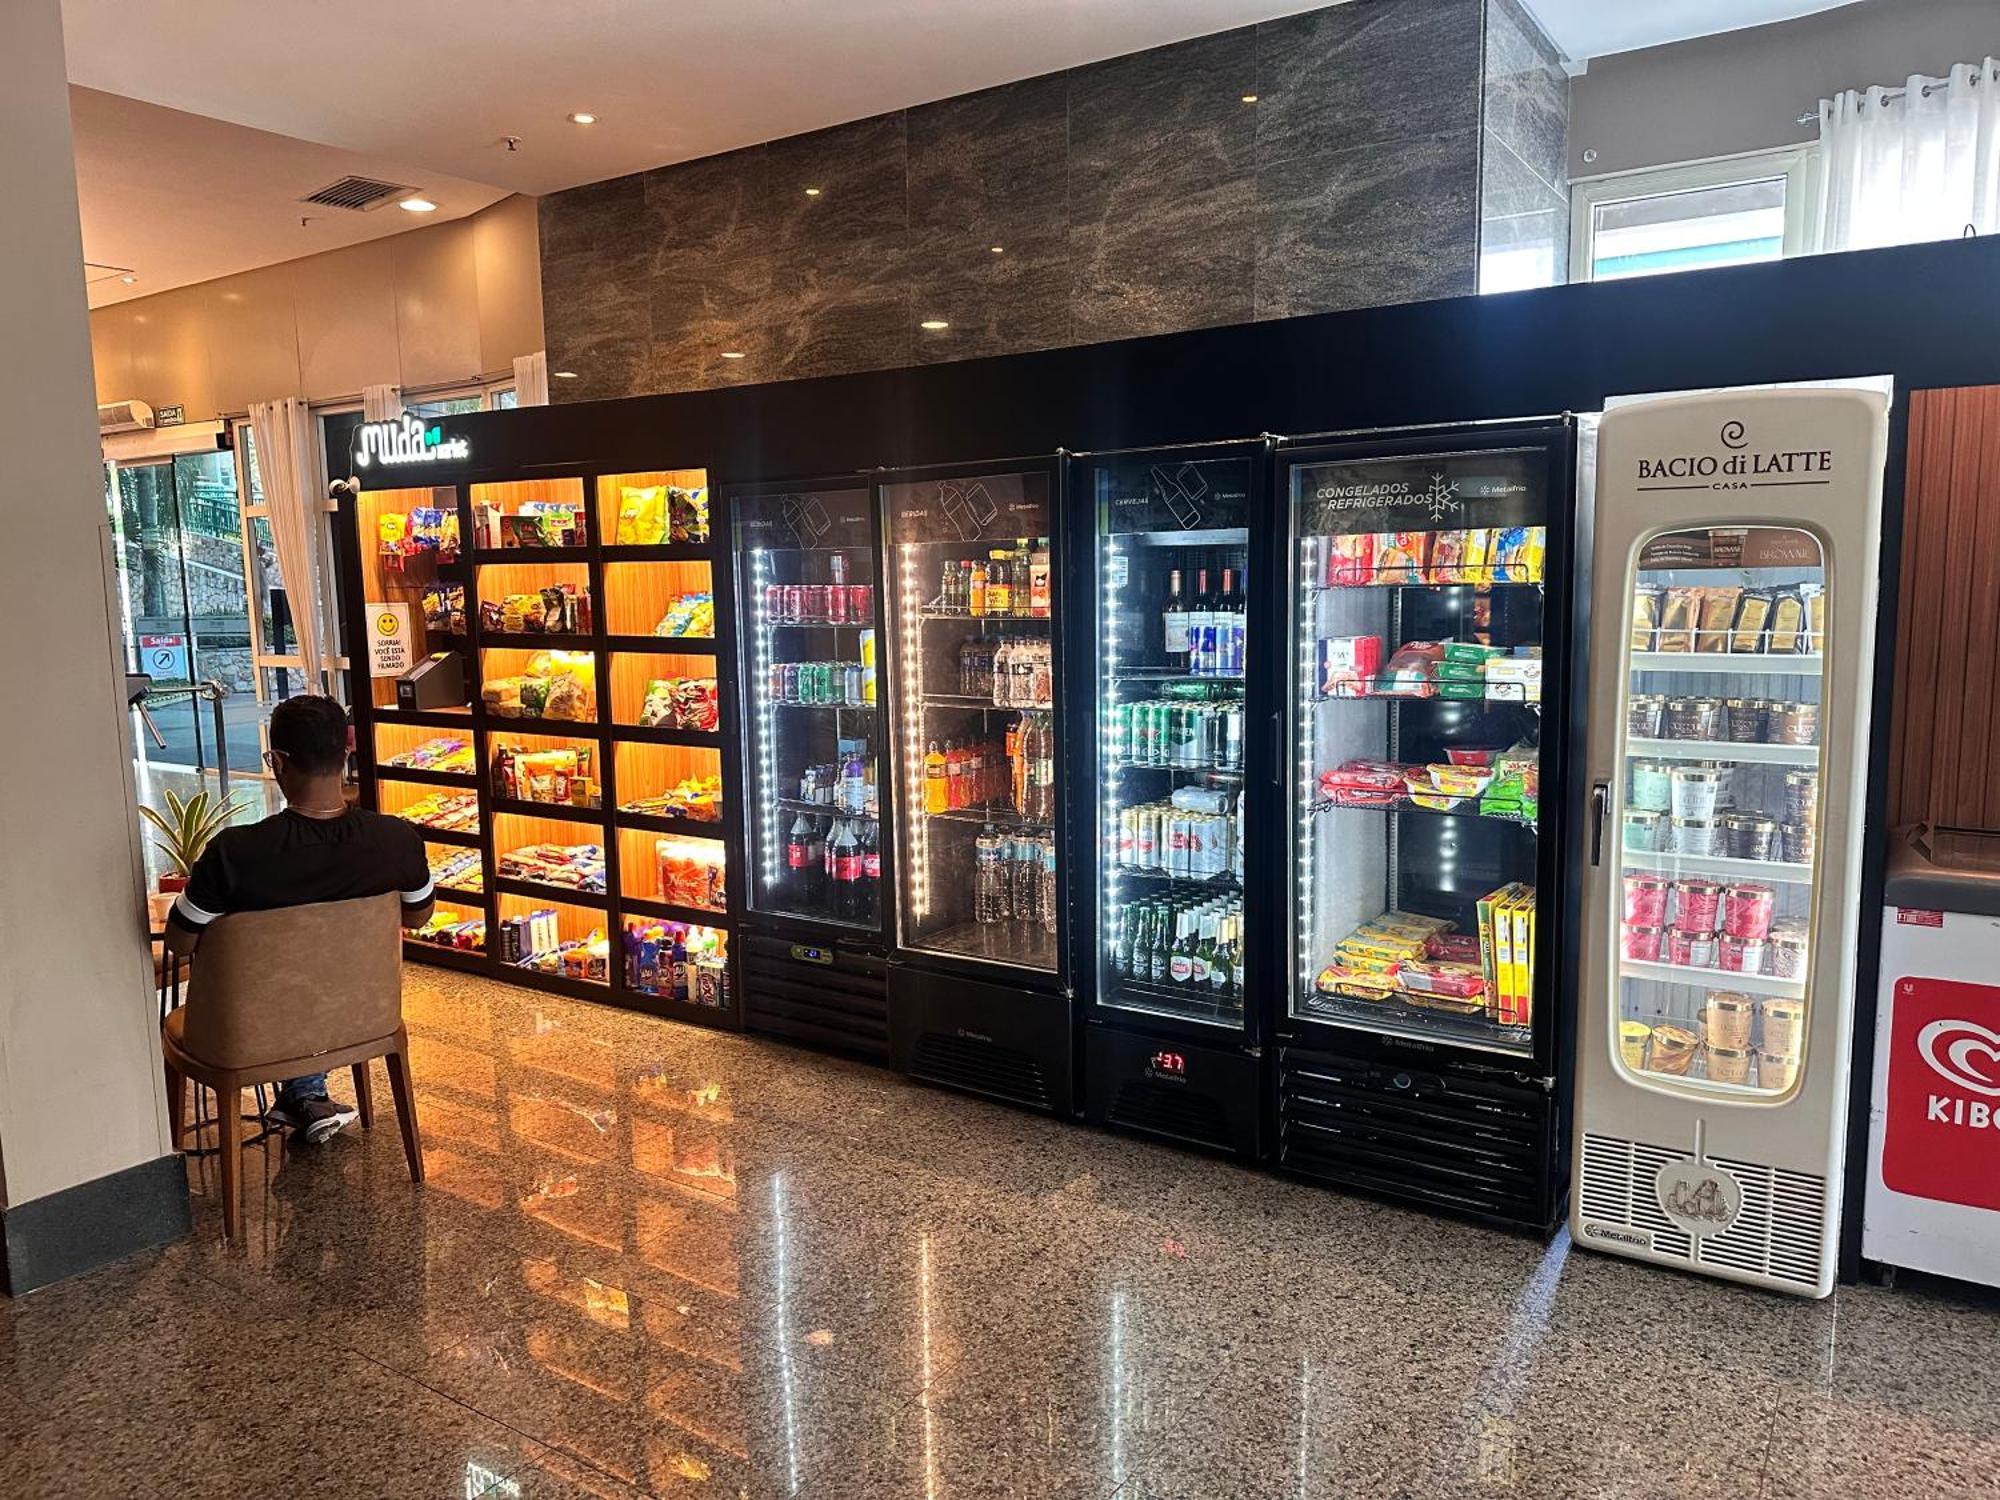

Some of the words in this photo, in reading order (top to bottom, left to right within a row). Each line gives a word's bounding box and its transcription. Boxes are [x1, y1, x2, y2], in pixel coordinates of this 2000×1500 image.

[1638, 455, 1718, 479] BACIO
[1723, 455, 1746, 475] di
[1752, 450, 1832, 474] LATTE
[1316, 482, 1409, 499] CONGELADOS
[1712, 482, 1748, 490] CASA
[1600, 1229, 1647, 1245] Metalfrio
